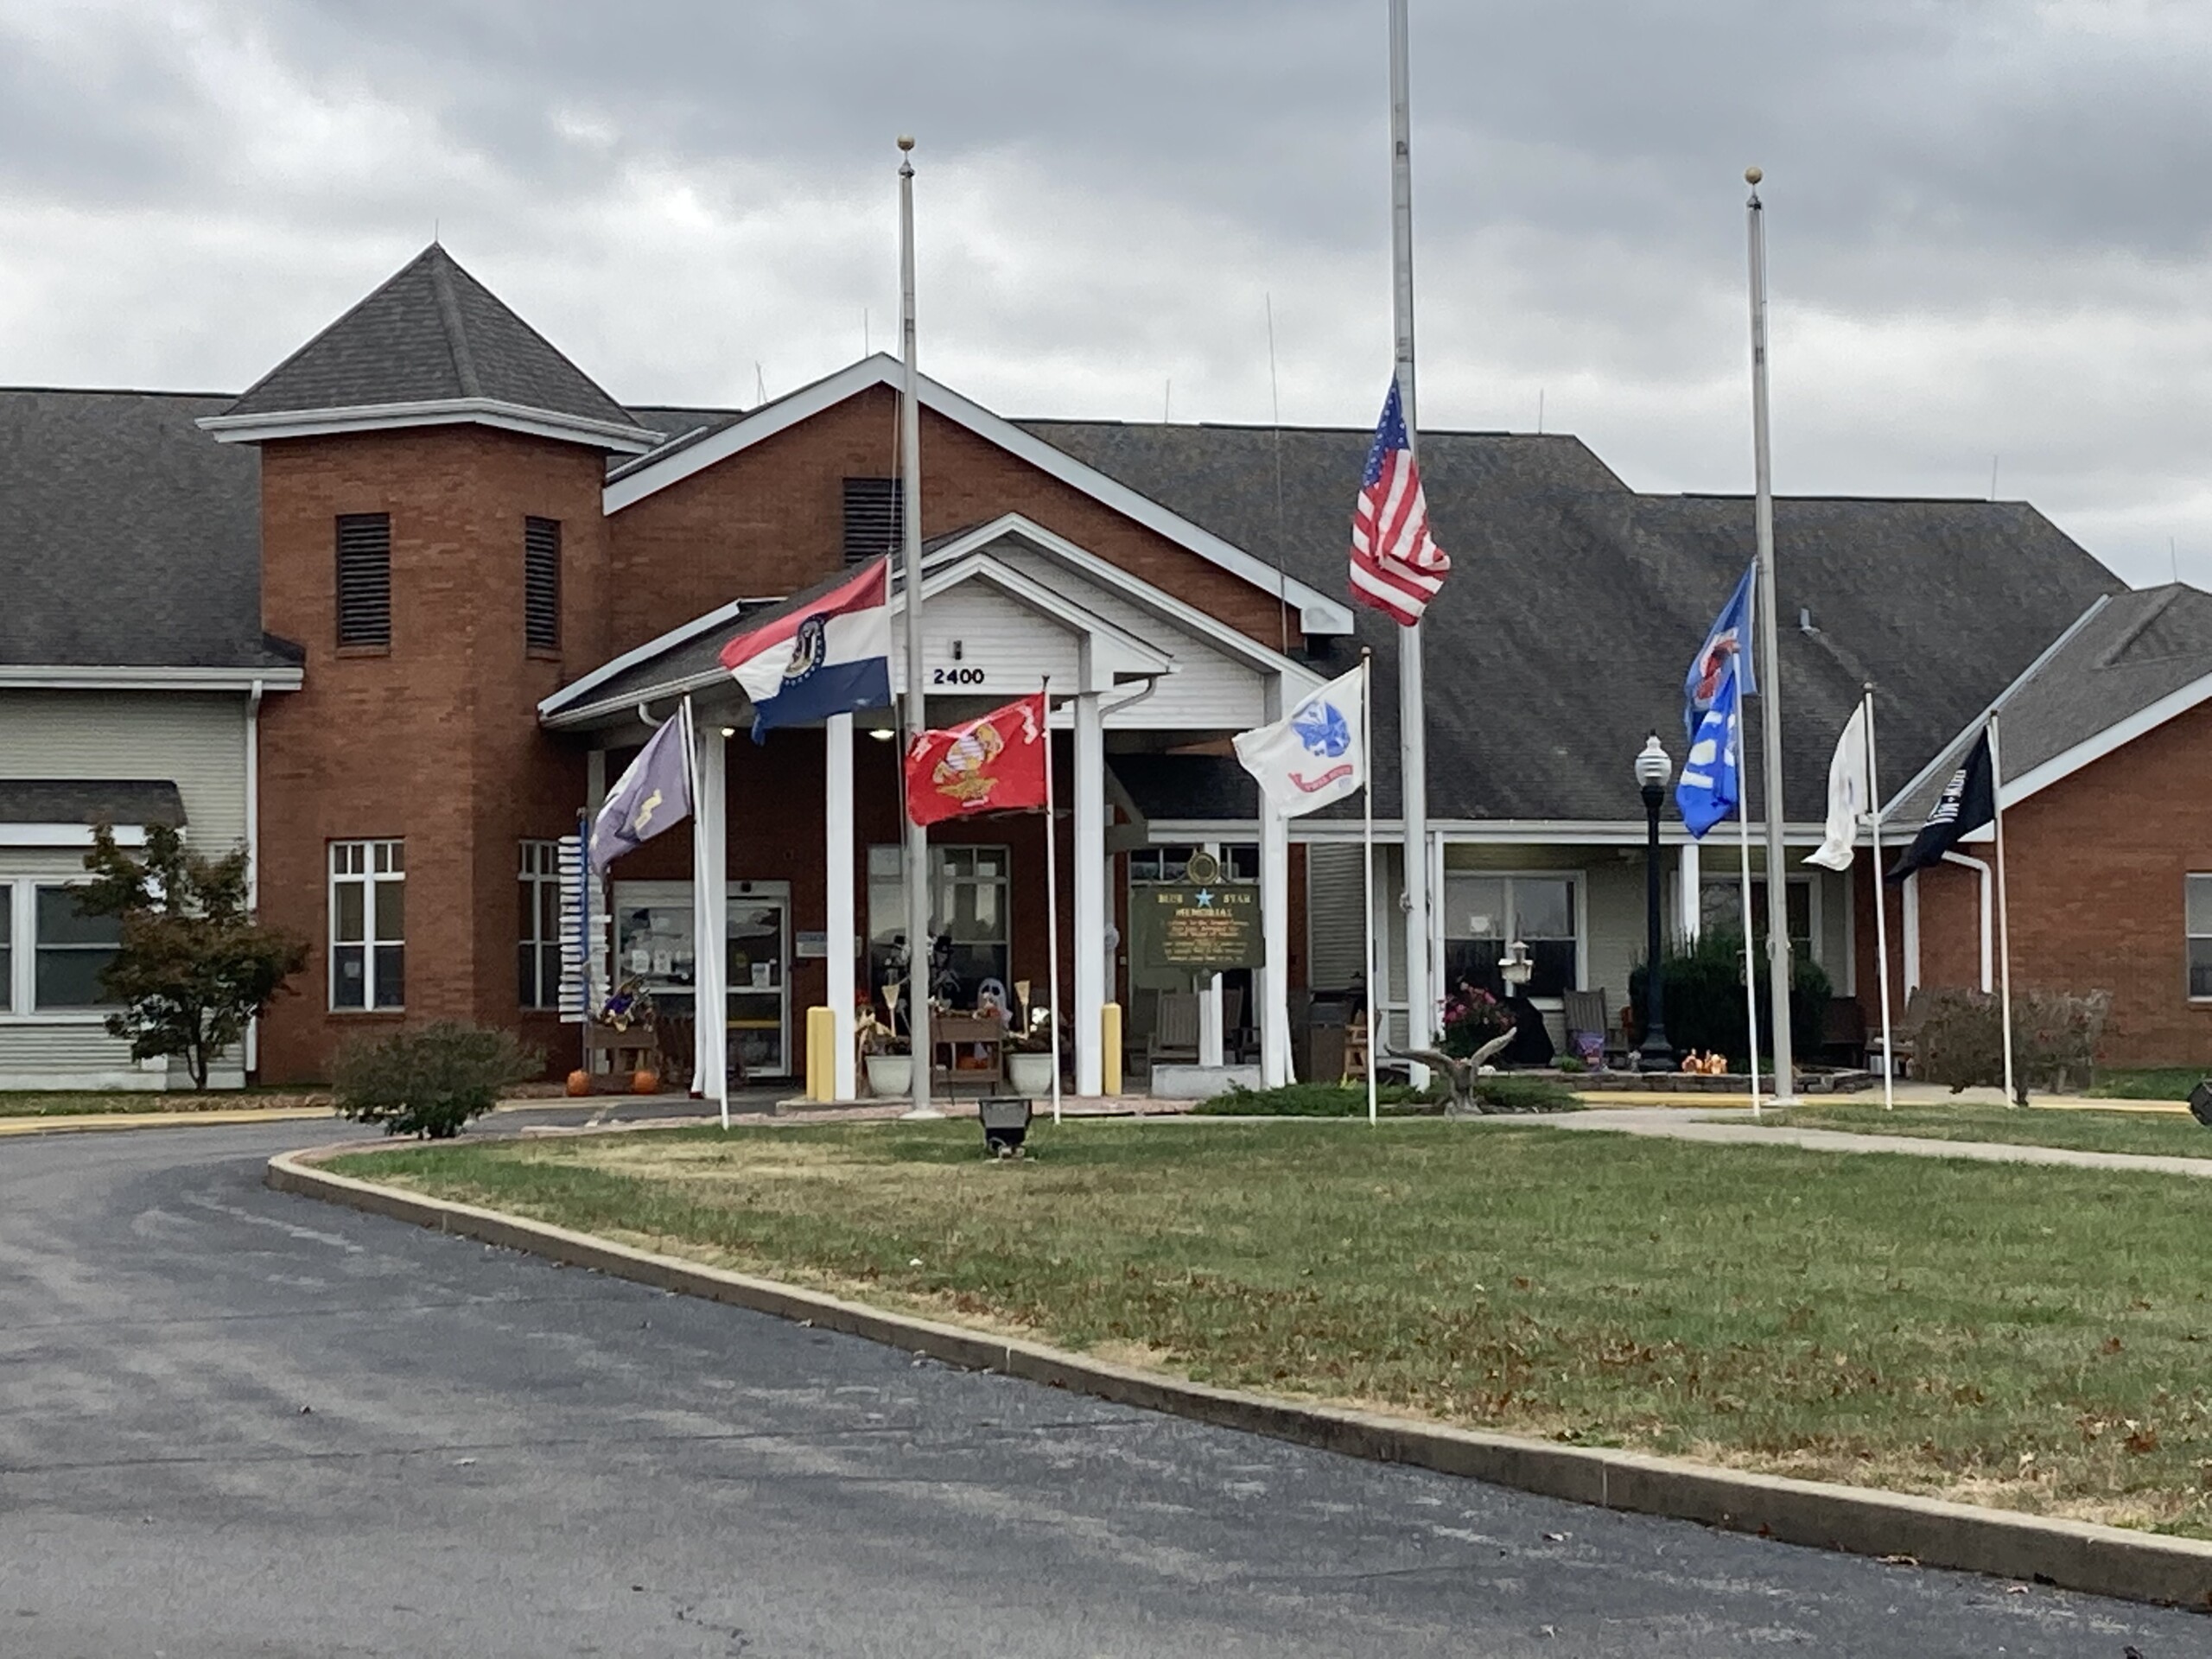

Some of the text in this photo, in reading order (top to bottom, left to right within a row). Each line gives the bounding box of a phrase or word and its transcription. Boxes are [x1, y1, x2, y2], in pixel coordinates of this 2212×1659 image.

[933, 668, 985, 685] 2400
[1223, 893, 1251, 904] STAR
[1175, 908, 1233, 918] MEMORIAL
